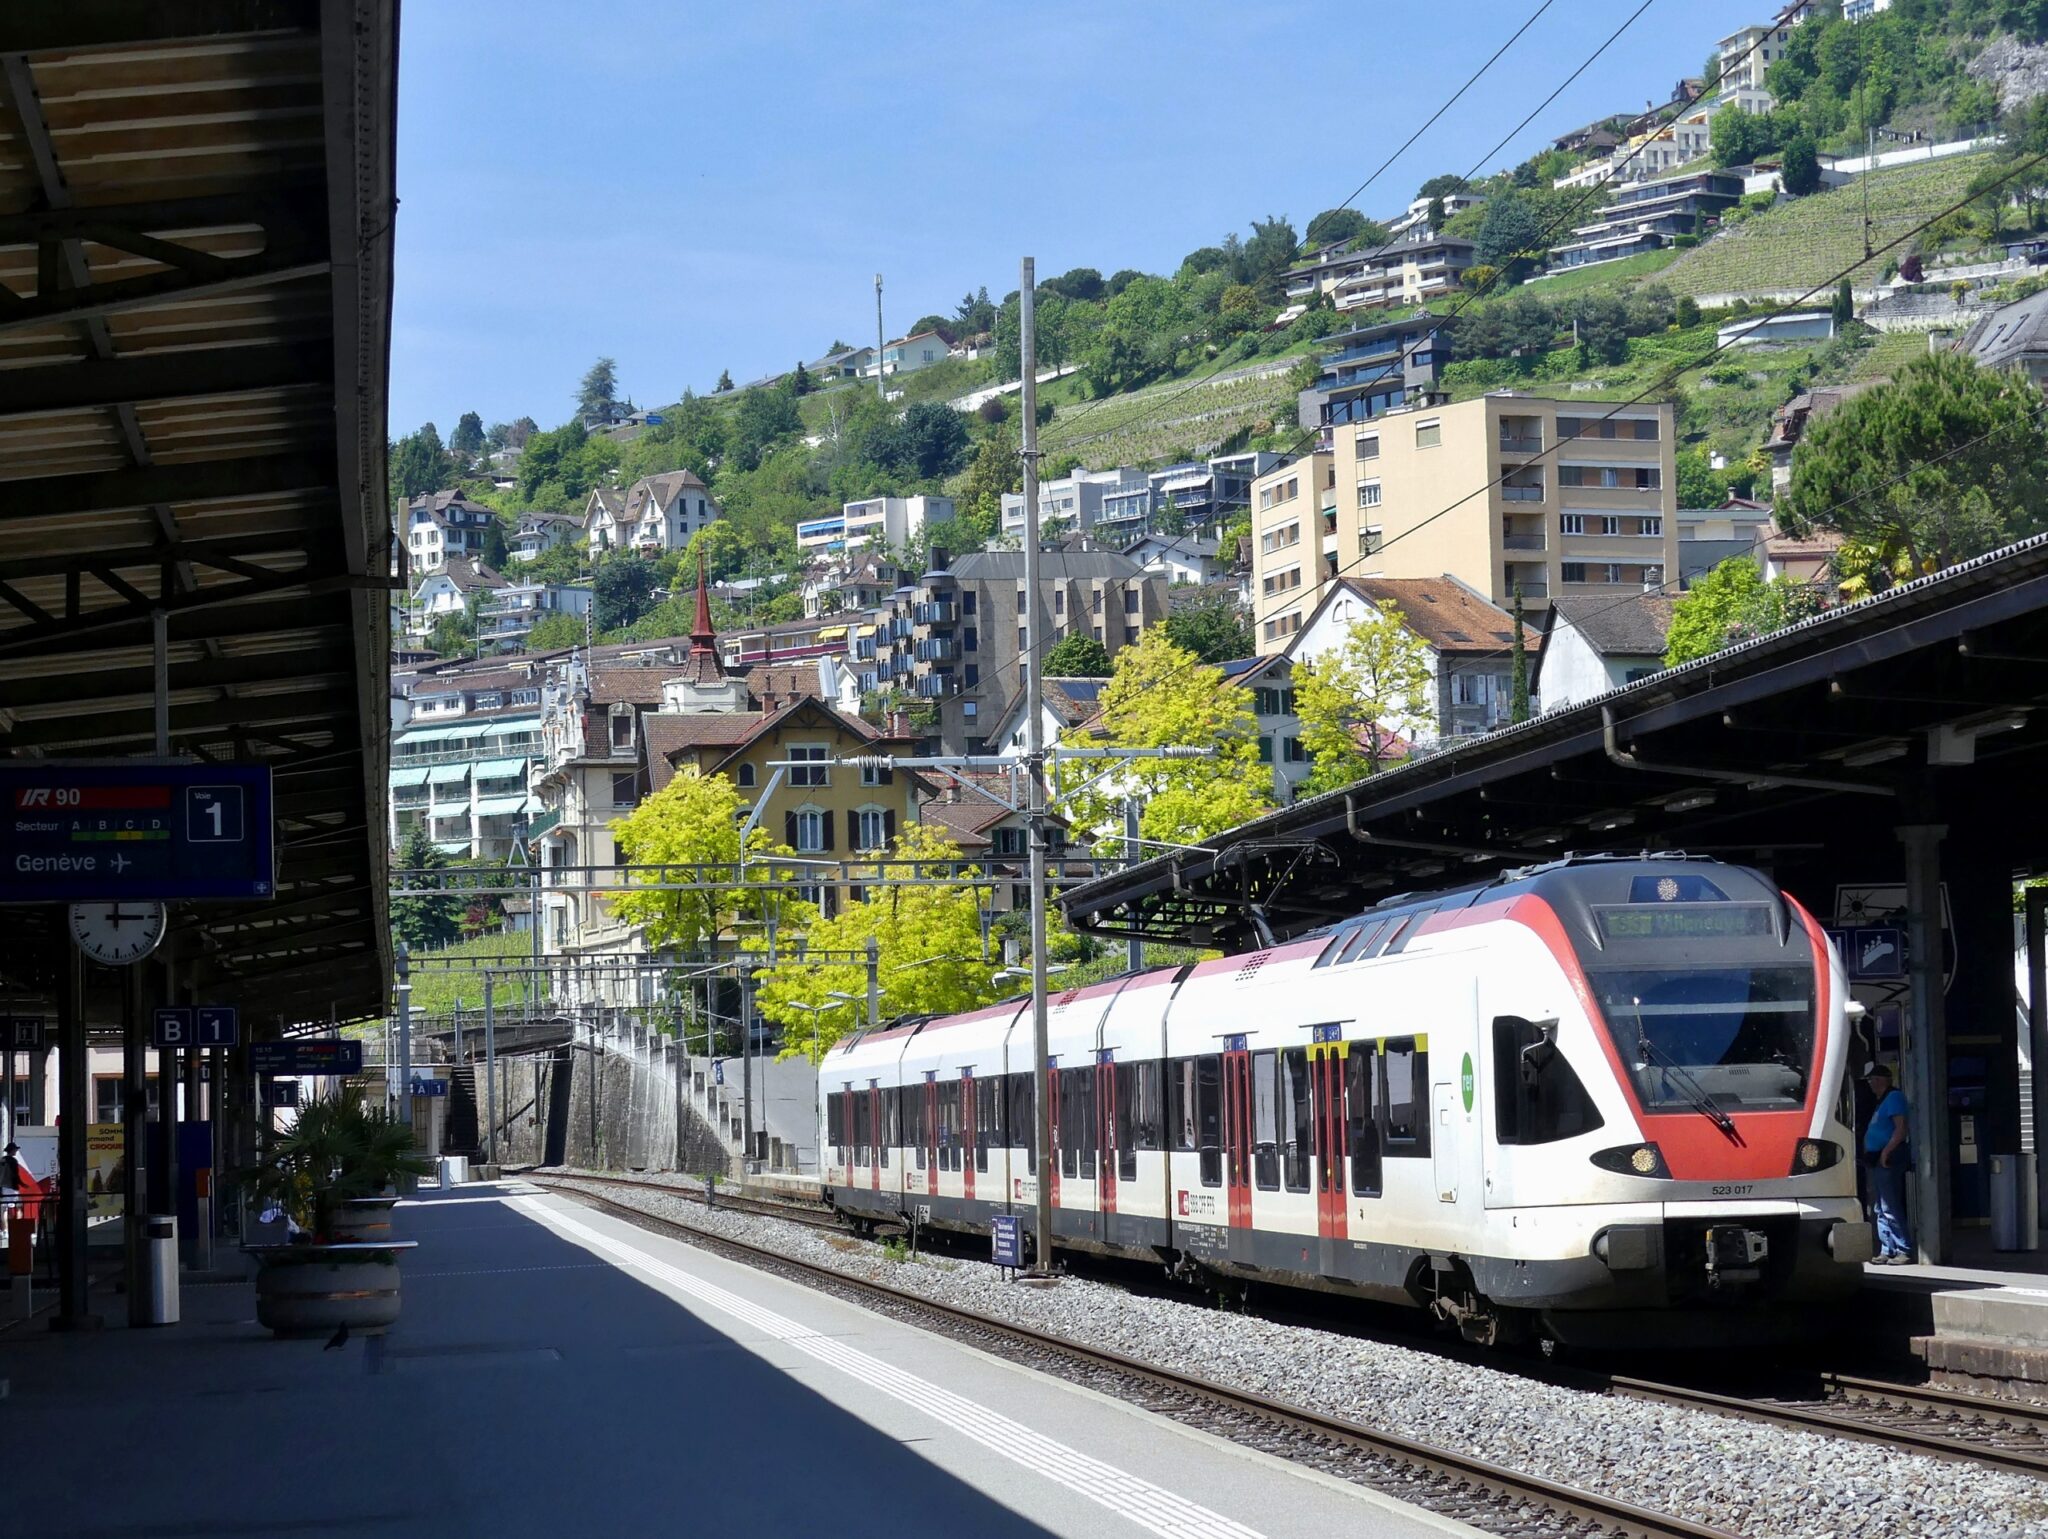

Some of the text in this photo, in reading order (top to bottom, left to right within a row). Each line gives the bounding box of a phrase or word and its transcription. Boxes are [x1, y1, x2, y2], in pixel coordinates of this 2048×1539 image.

[56, 788, 81, 806] 90
[194, 791, 212, 800] Voie
[15, 819, 161, 832] Secteur A B C D
[204, 801, 222, 837] 1
[15, 853, 96, 872] Genève
[164, 1020, 182, 1041] B
[210, 1019, 220, 1041] 1
[344, 1049, 351, 1060] 1
[281, 1089, 288, 1102] 1
[418, 1085, 426, 1094] A
[437, 1084, 441, 1094] 1
[1712, 1185, 1753, 1195] 523 017
[920, 1206, 929, 1215] 24
